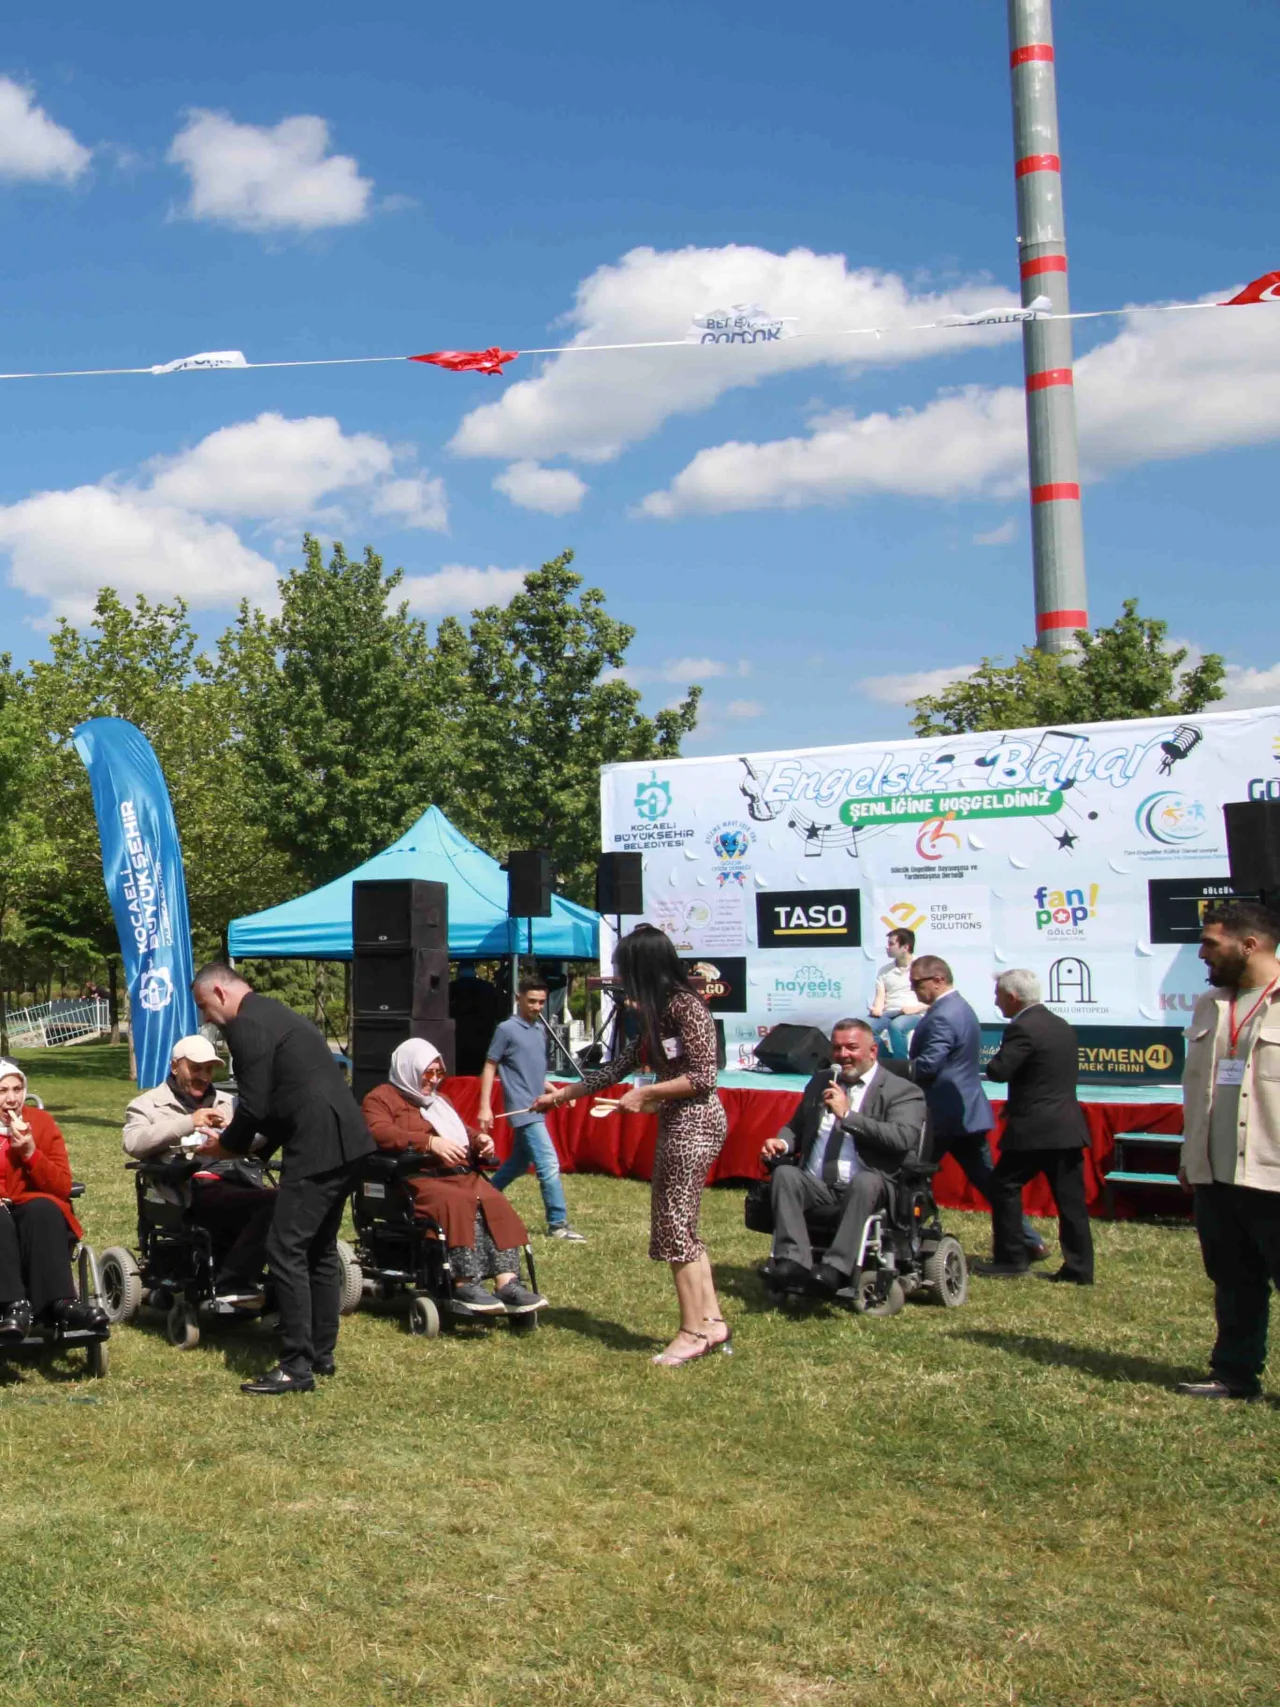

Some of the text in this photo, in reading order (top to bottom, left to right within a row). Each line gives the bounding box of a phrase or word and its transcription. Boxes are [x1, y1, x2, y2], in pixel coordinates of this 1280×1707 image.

[762, 732, 1175, 808] Engelsiz Bahar
[939, 790, 1051, 815] HOŞGELDİNİZ
[630, 822, 677, 832] KOCAELİ
[614, 829, 695, 843] BÜYÜKŞEHİR
[623, 840, 685, 850] BELEDİYESİ
[121, 799, 160, 950] BÜYÜKŞEHİR
[121, 867, 148, 954] KOCAELİ
[930, 904, 948, 912] ETB
[774, 904, 847, 928] TASO
[930, 912, 973, 921] SUPPORT
[931, 921, 982, 930] SOLUTIONS
[1047, 928, 1084, 936] GÖLCÜK
[775, 978, 842, 995] hayeels
[1107, 1063, 1145, 1073] FIRINI
